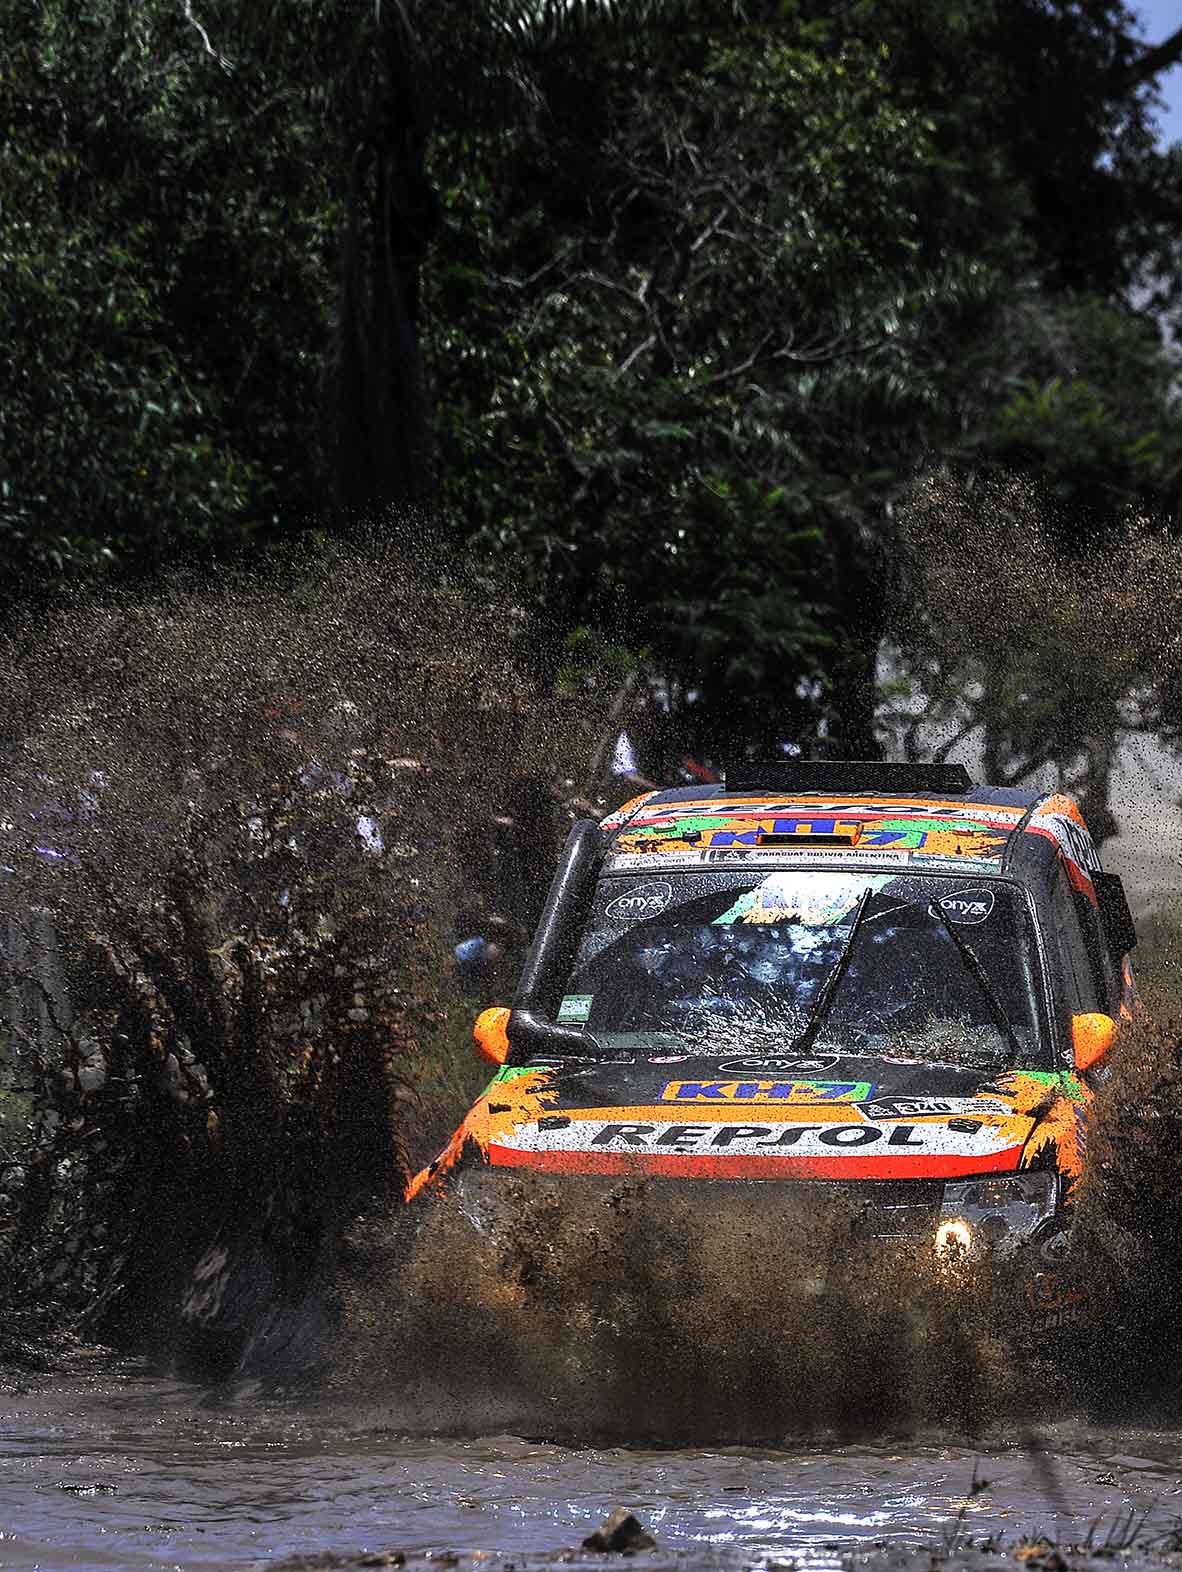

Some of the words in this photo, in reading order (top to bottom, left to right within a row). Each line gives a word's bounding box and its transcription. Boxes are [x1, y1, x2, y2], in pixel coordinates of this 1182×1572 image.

[940, 900, 987, 915] onyx
[742, 1059, 825, 1070] onyx
[676, 1082, 857, 1099] KH-7
[901, 1102, 951, 1114] 340
[591, 1124, 924, 1147] REPSOL
